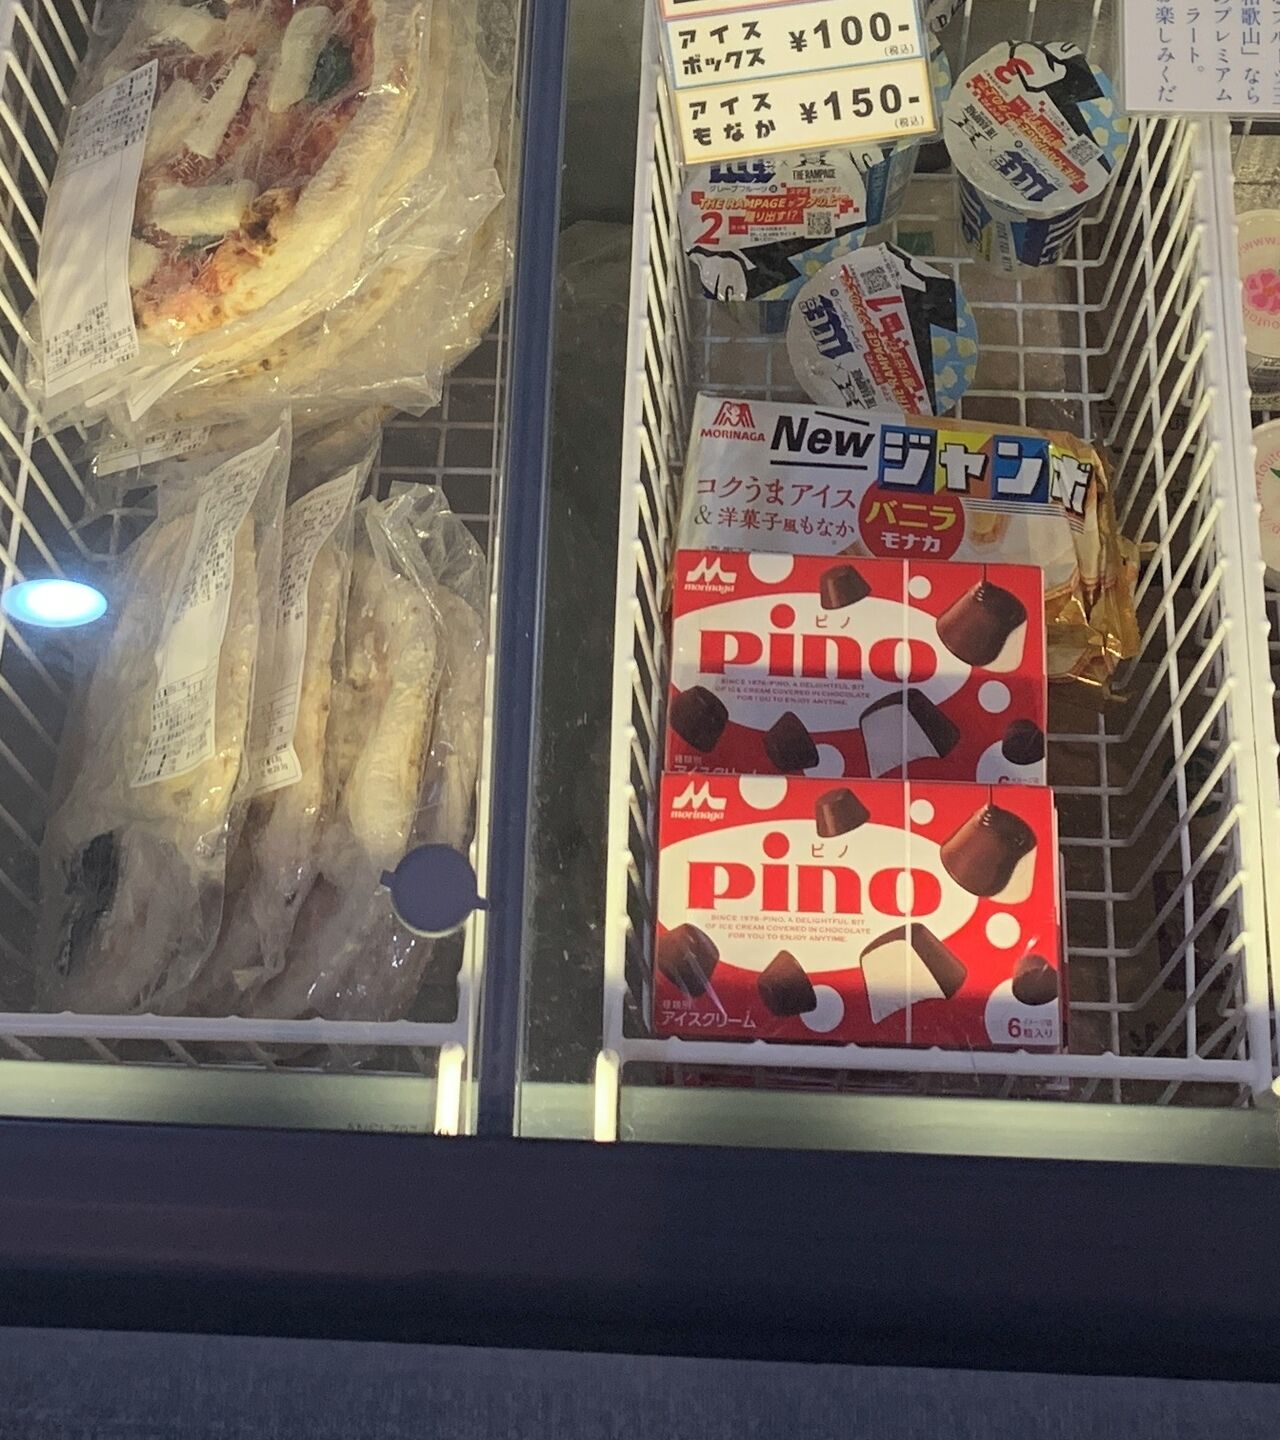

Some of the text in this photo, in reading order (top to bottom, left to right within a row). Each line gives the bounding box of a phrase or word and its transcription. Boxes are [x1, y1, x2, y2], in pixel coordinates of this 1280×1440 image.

[678, 21, 762, 49] アイス
[884, 42, 914, 56] (税込)
[682, 47, 766, 75] ボックス
[689, 92, 773, 120] アイス
[894, 115, 925, 128] (税込)
[693, 119, 776, 146] もなか
[793, 168, 836, 180] THE RAMPAGE
[699, 196, 786, 210] THE RAMPAGE
[693, 210, 723, 245] 2
[701, 428, 766, 443] MORINAGA
[770, 414, 876, 459] New
[696, 476, 856, 510] コクうまアイス
[864, 499, 960, 531] バニラ
[880, 531, 941, 554] モナカ
[684, 581, 735, 594] morinaga
[815, 614, 851, 630] ピノ
[699, 603, 938, 683] pino
[670, 809, 725, 823] morinaga
[811, 842, 850, 859] ピノ
[687, 831, 943, 918] pino
[766, 925, 806, 933] COVERED
[819, 927, 872, 935] CHOCOLATE
[661, 1009, 757, 1030] アイスクリーム
[1007, 1017, 1021, 1038] 6
